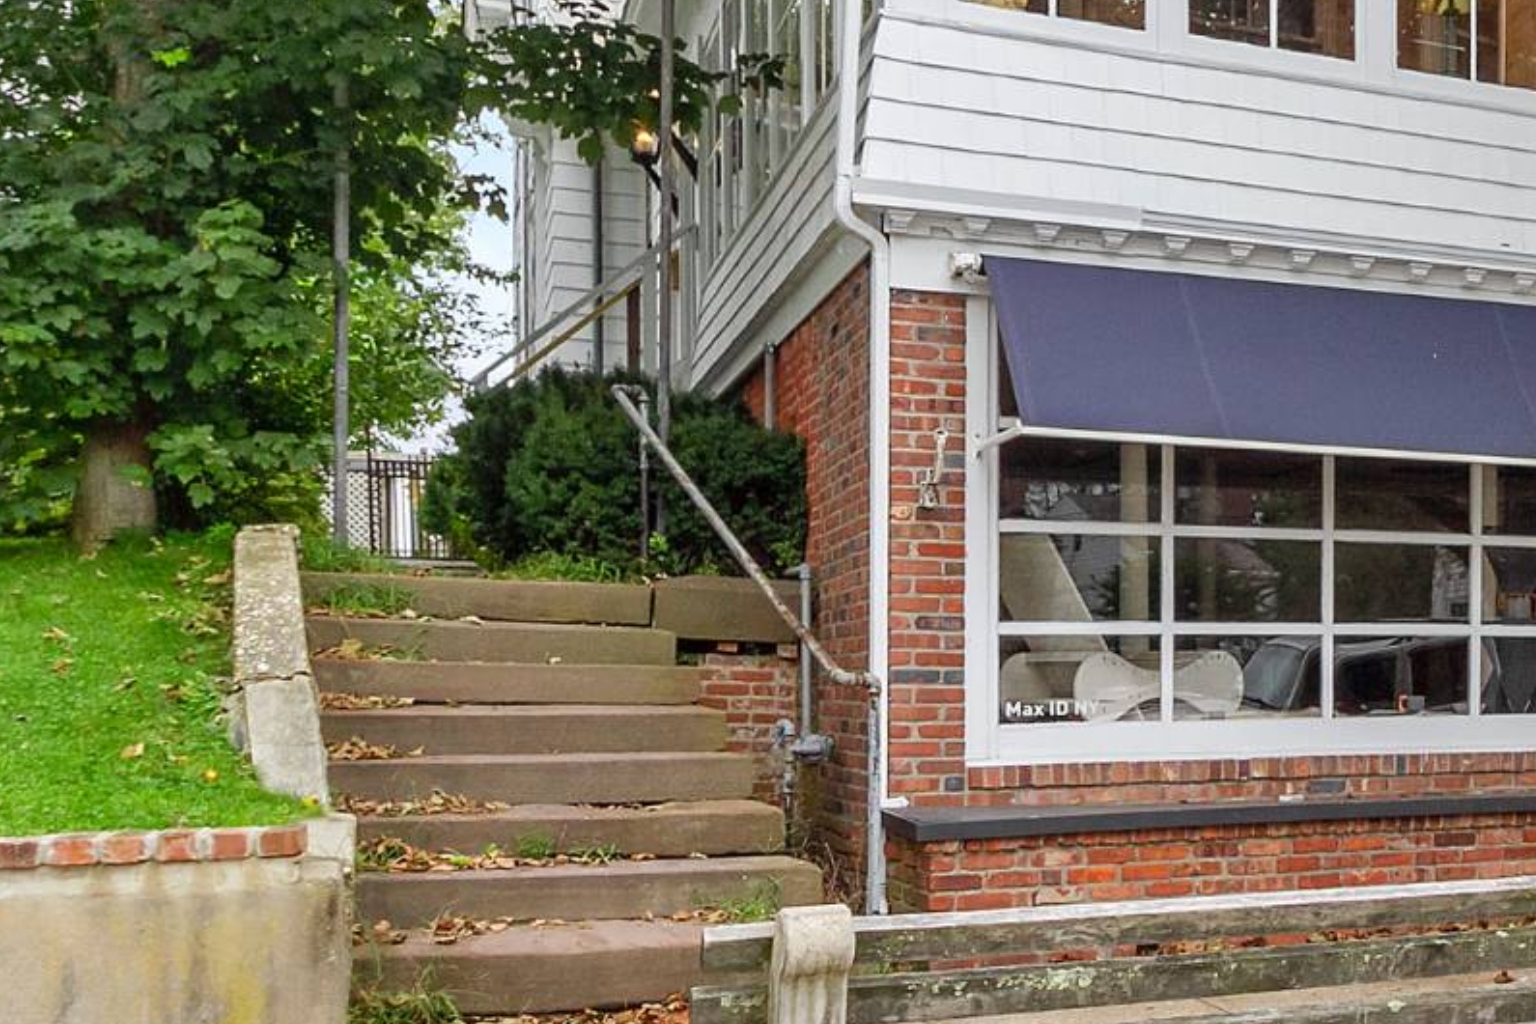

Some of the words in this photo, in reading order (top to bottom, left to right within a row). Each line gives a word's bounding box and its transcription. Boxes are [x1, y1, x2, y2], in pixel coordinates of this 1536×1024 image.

[1005, 700, 1045, 717] Max
[1049, 699, 1069, 716] ID
[1074, 698, 1100, 716] NY
